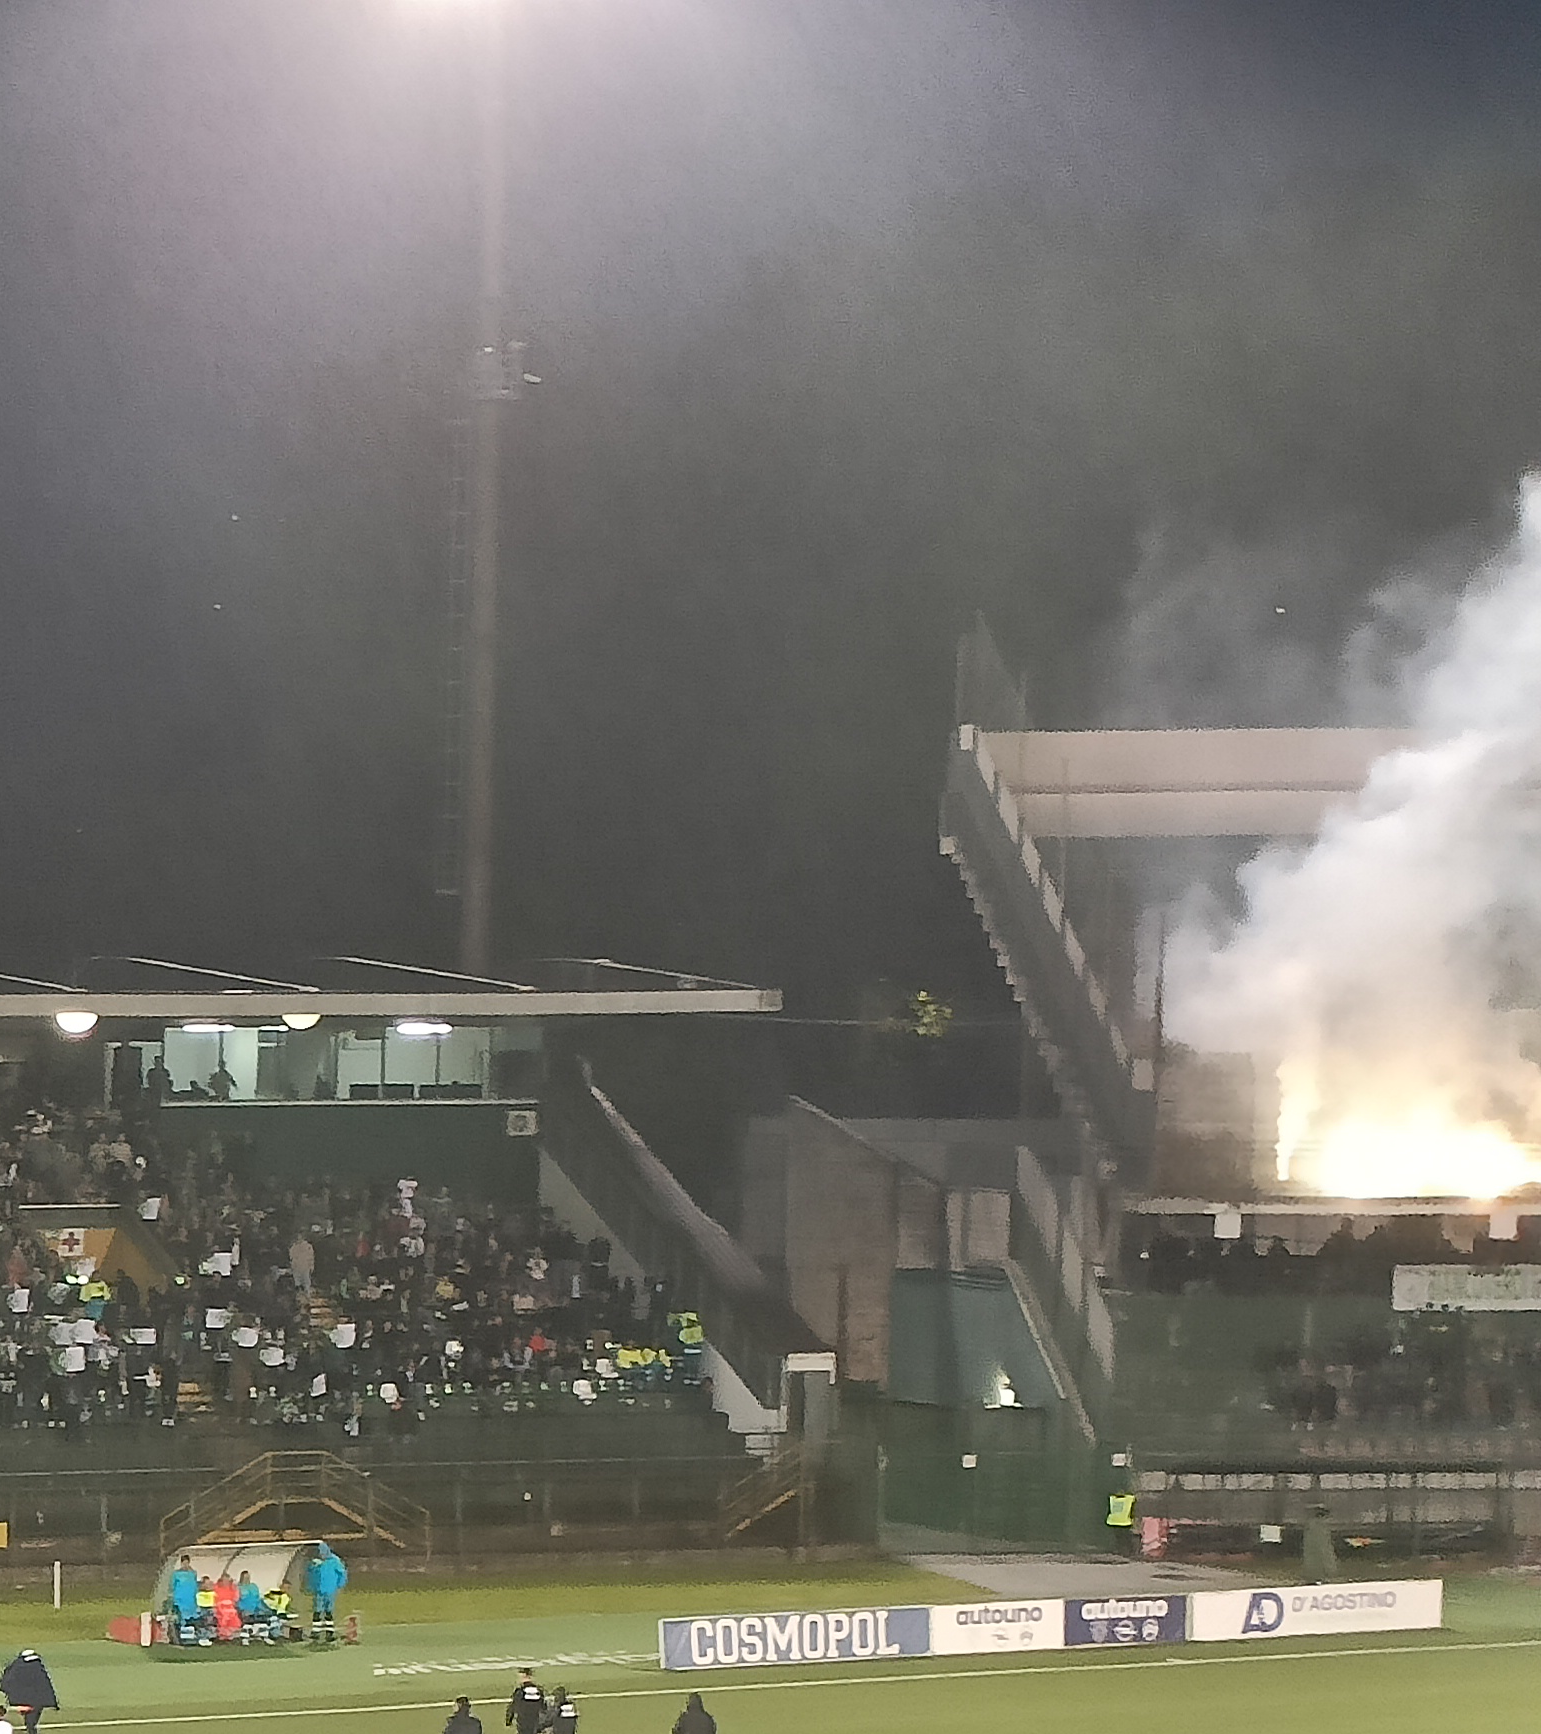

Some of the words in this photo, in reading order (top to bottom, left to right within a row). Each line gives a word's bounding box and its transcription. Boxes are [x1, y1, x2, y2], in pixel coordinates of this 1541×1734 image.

[956, 1606, 1043, 1625] autouno
[1081, 1599, 1168, 1620] autouno
[690, 1610, 900, 1665] COSMOPOL
